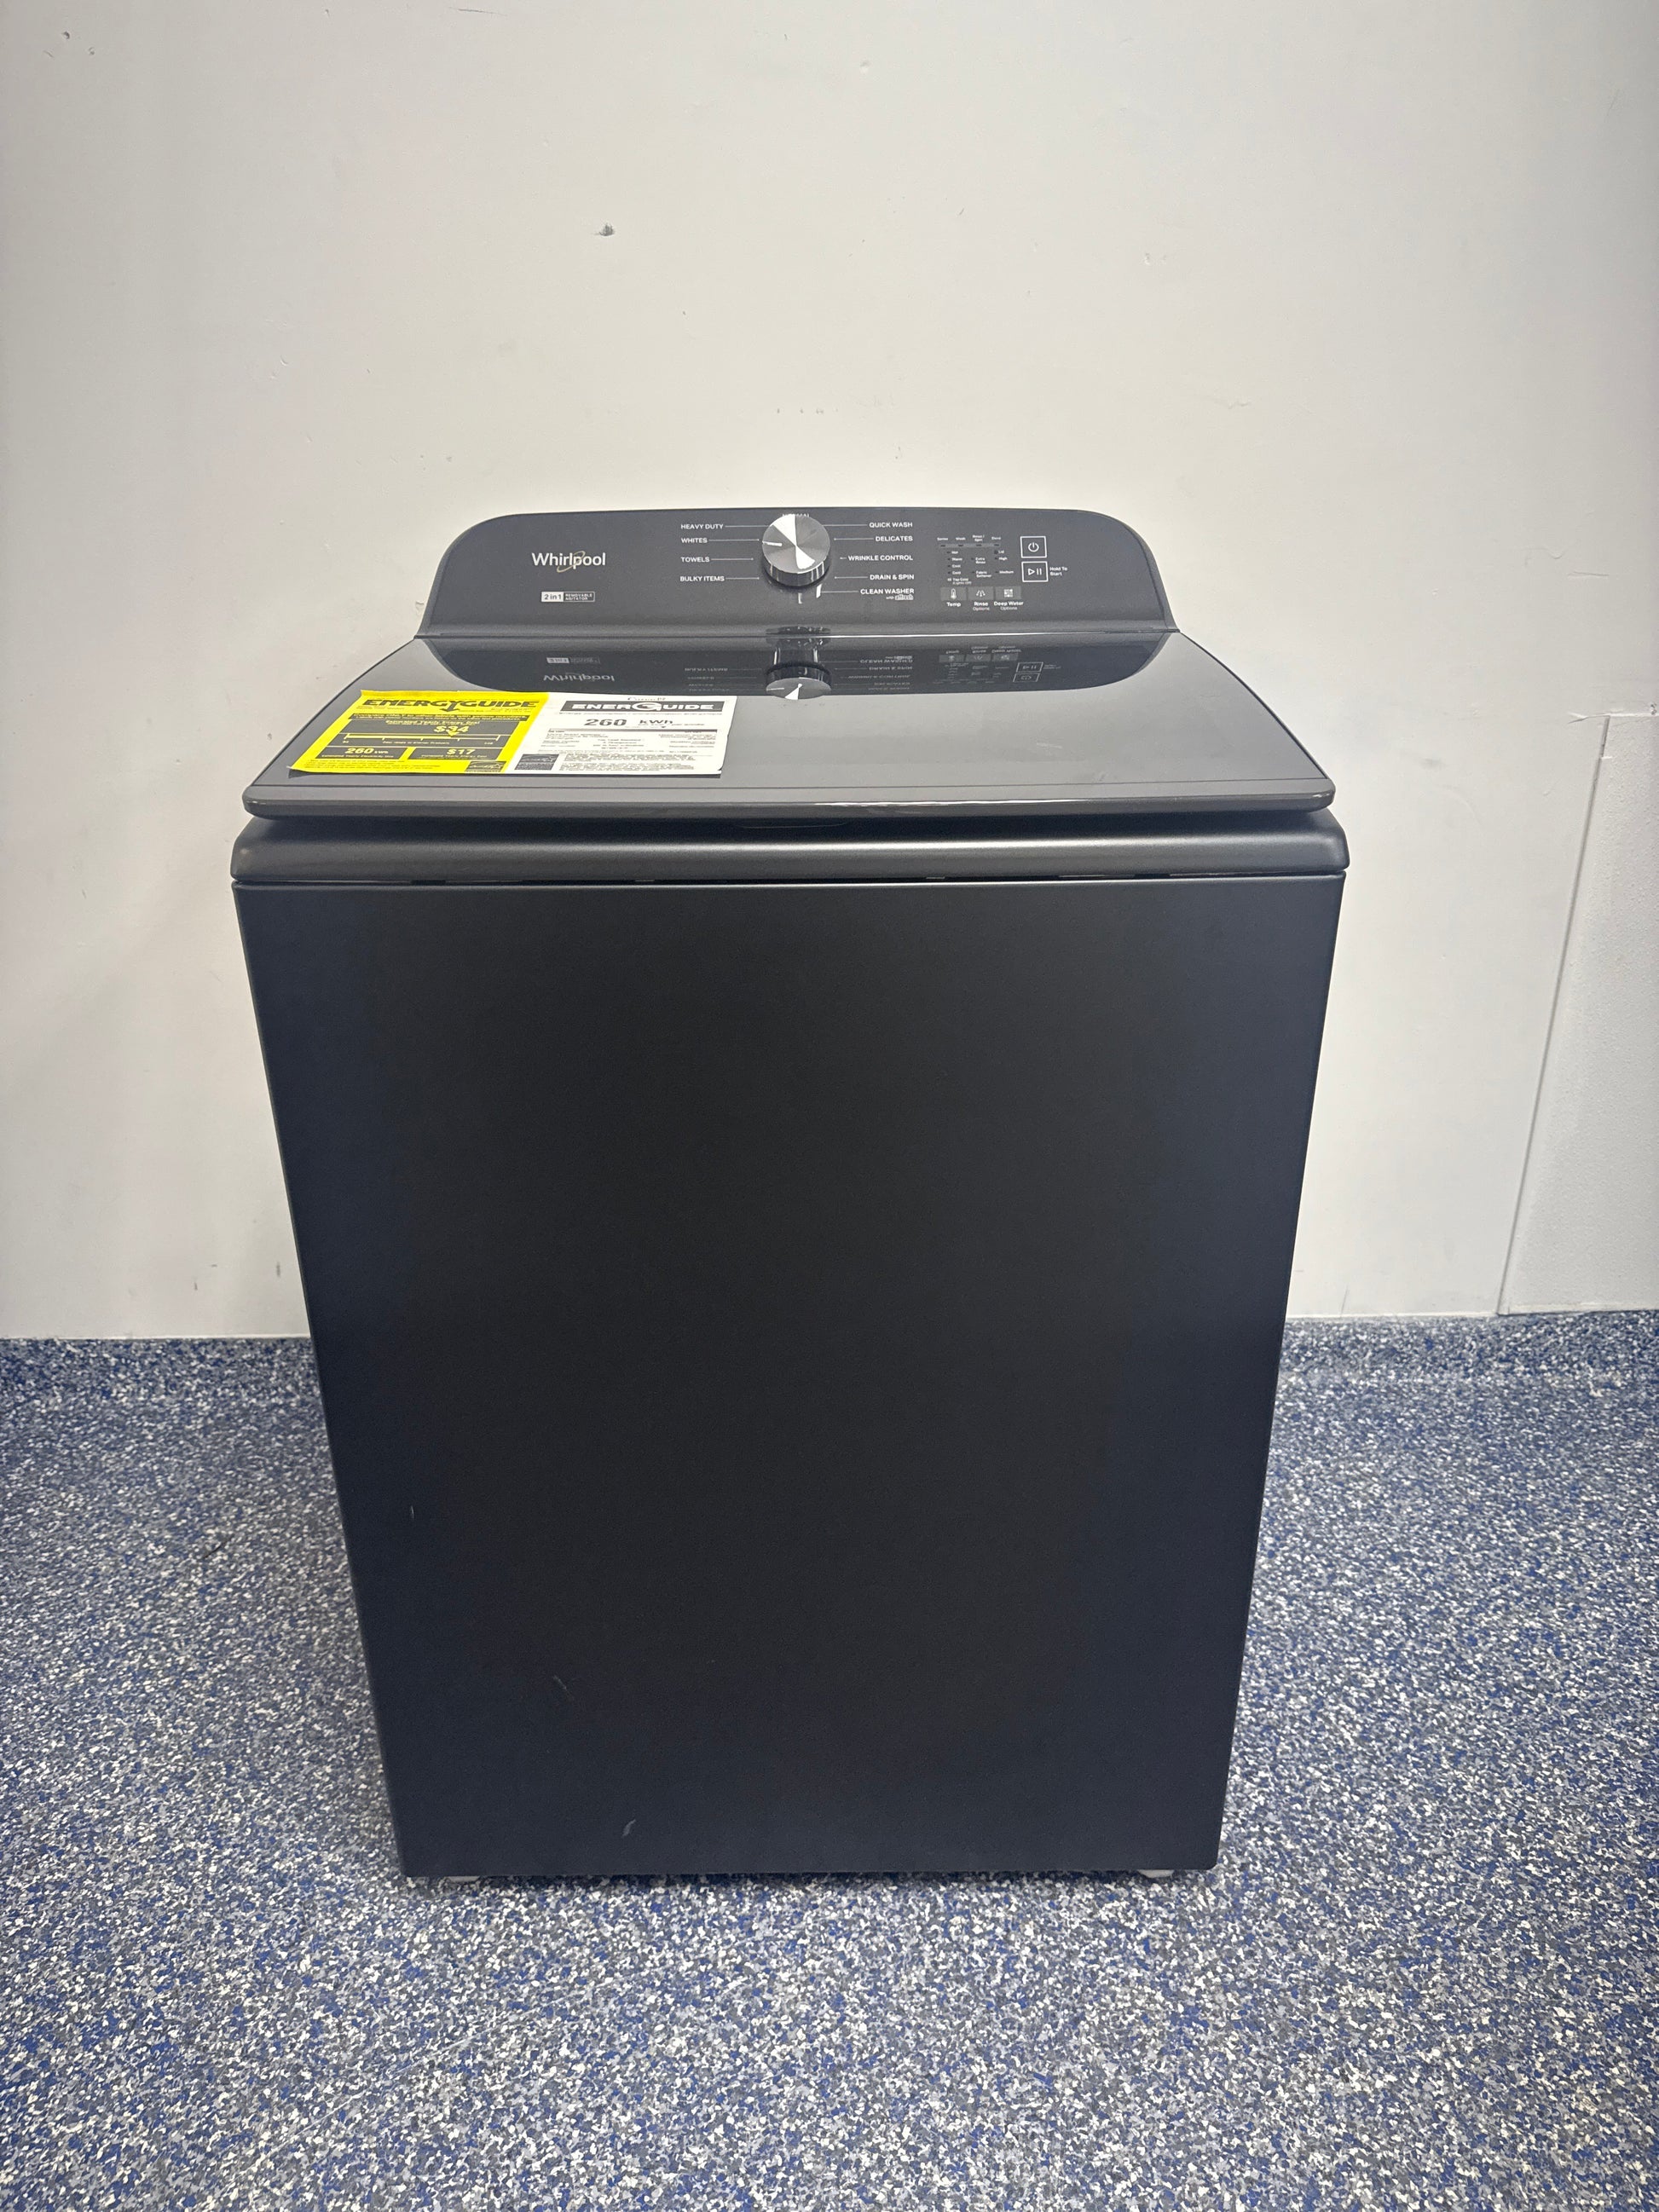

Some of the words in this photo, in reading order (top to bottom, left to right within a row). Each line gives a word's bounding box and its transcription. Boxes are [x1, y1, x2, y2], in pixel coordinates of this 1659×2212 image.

[531, 552, 606, 570] Whirlpool
[361, 698, 540, 712] ENERGYGUIDE
[570, 702, 714, 711] ENERGUIDE
